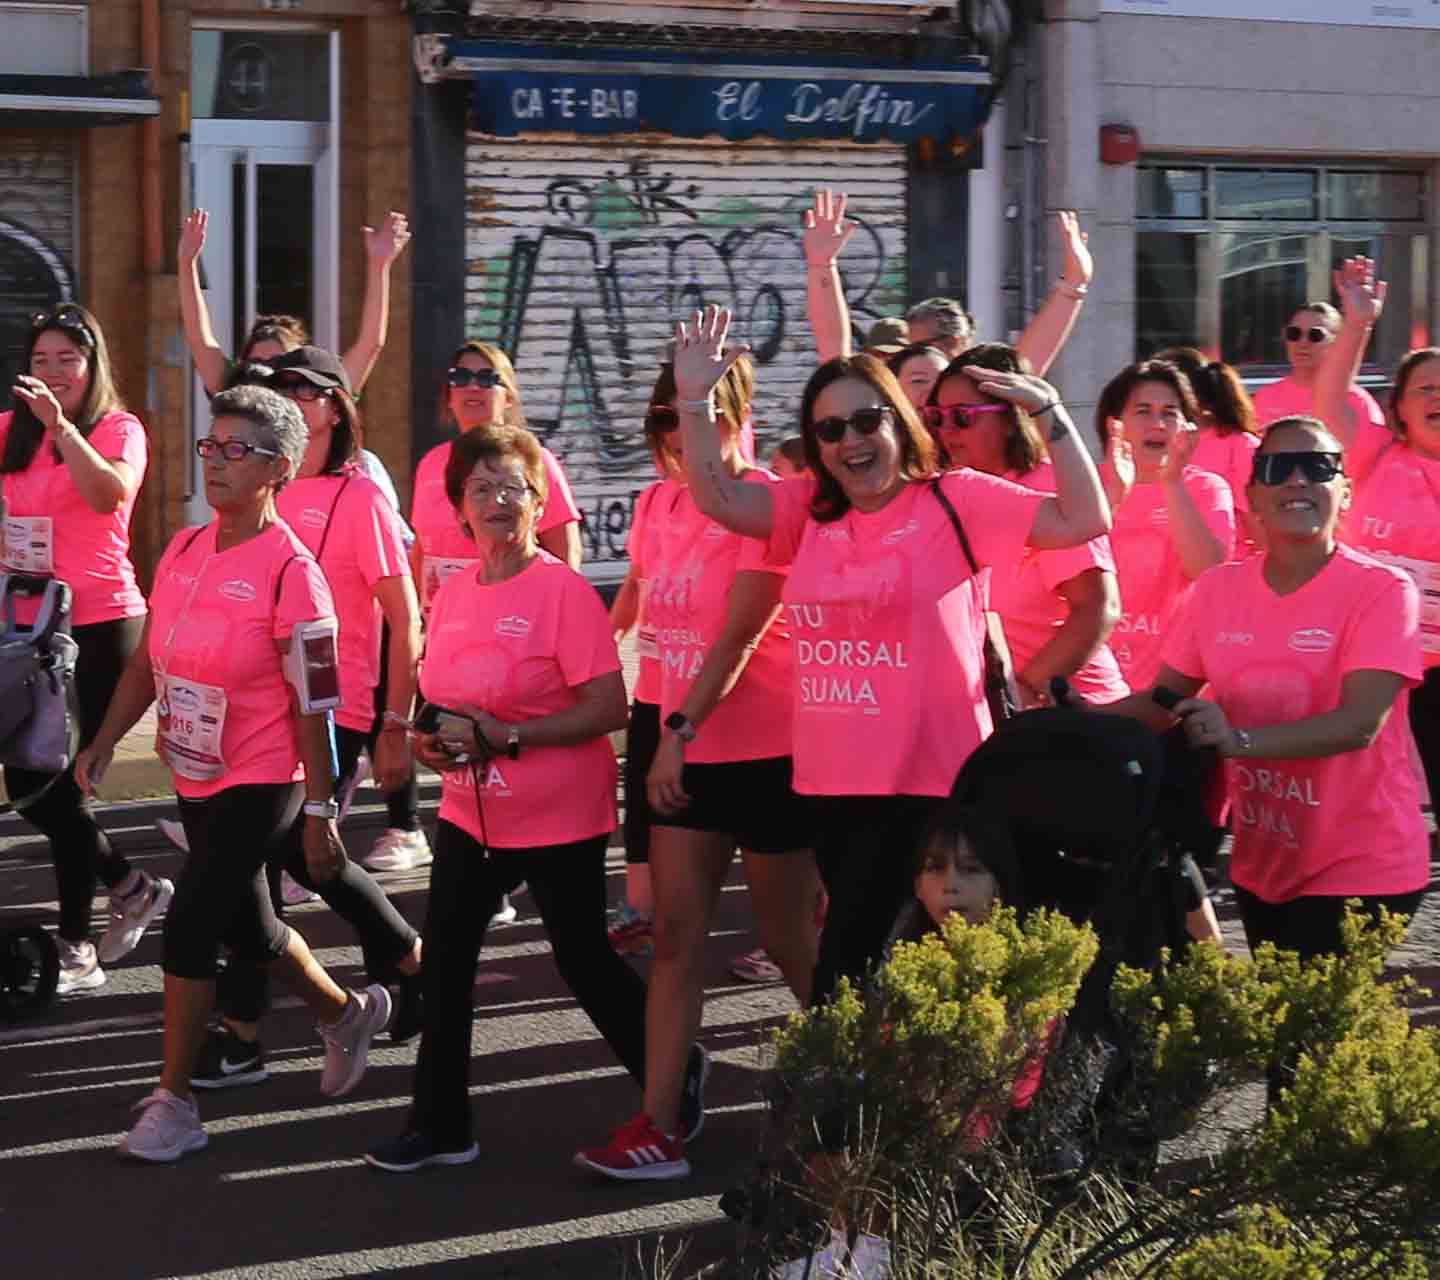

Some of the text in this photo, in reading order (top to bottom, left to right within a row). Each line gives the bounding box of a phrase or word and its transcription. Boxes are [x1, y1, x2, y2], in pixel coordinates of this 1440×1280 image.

[712, 81, 762, 121] El
[784, 83, 935, 136] Delfin
[790, 604, 823, 627] TU
[799, 640, 908, 668] DORSAL
[800, 677, 877, 705] SUMA
